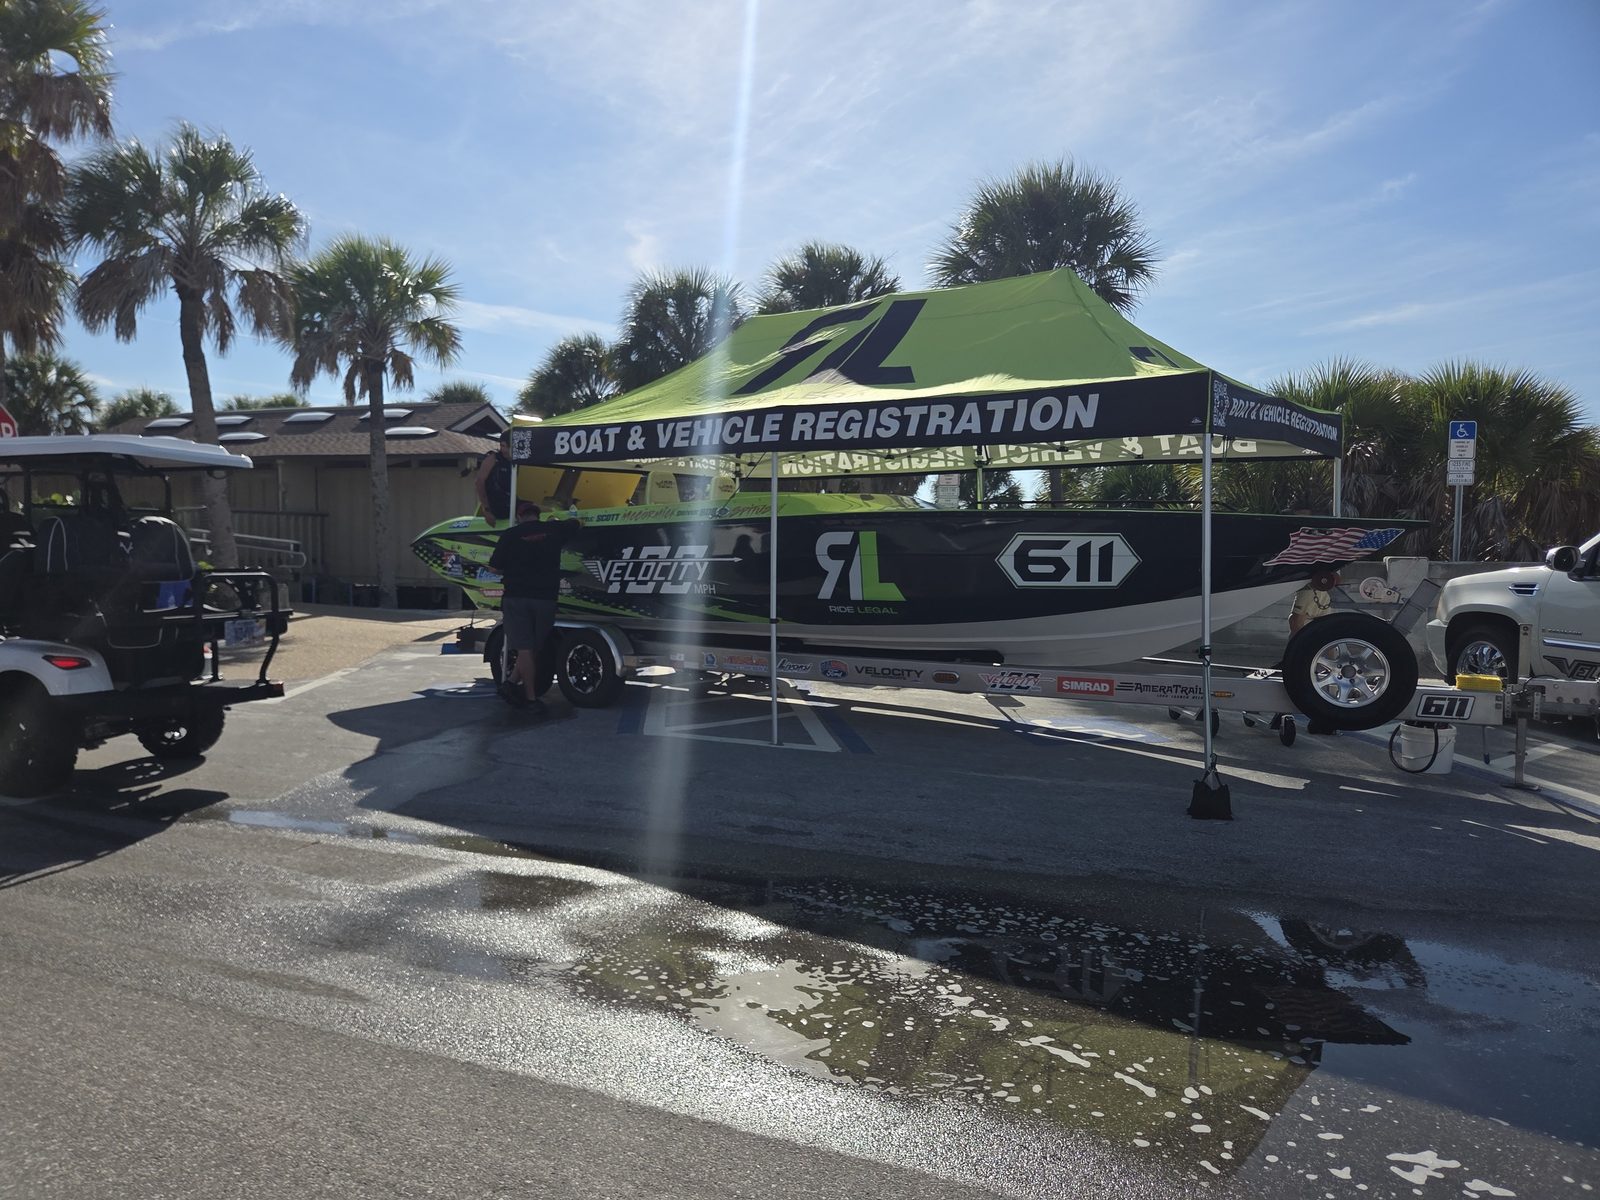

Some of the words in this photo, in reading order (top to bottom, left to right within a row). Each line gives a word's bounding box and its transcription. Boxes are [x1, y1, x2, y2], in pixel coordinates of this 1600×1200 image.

[554, 426, 621, 455] BOAT
[626, 425, 646, 451] &
[656, 413, 783, 448] VEHICLE
[791, 393, 1100, 442] REGISTRATION
[1229, 398, 1255, 420] BOAT
[1250, 403, 1260, 420] &
[1259, 404, 1290, 426] VEHICLE
[1290, 412, 1337, 442] REGISTRATION
[596, 513, 621, 522] SCOTT
[1013, 539, 1115, 583] 611
[582, 560, 709, 584] VELOCITY
[694, 584, 716, 594] MPH
[829, 606, 854, 614] RIDE
[857, 607, 898, 615] LEGAL
[854, 665, 924, 679] VELOCITY
[1543, 655, 1600, 681] VEL
[1062, 680, 1110, 692] SIMRAD
[1421, 697, 1470, 718] 611
